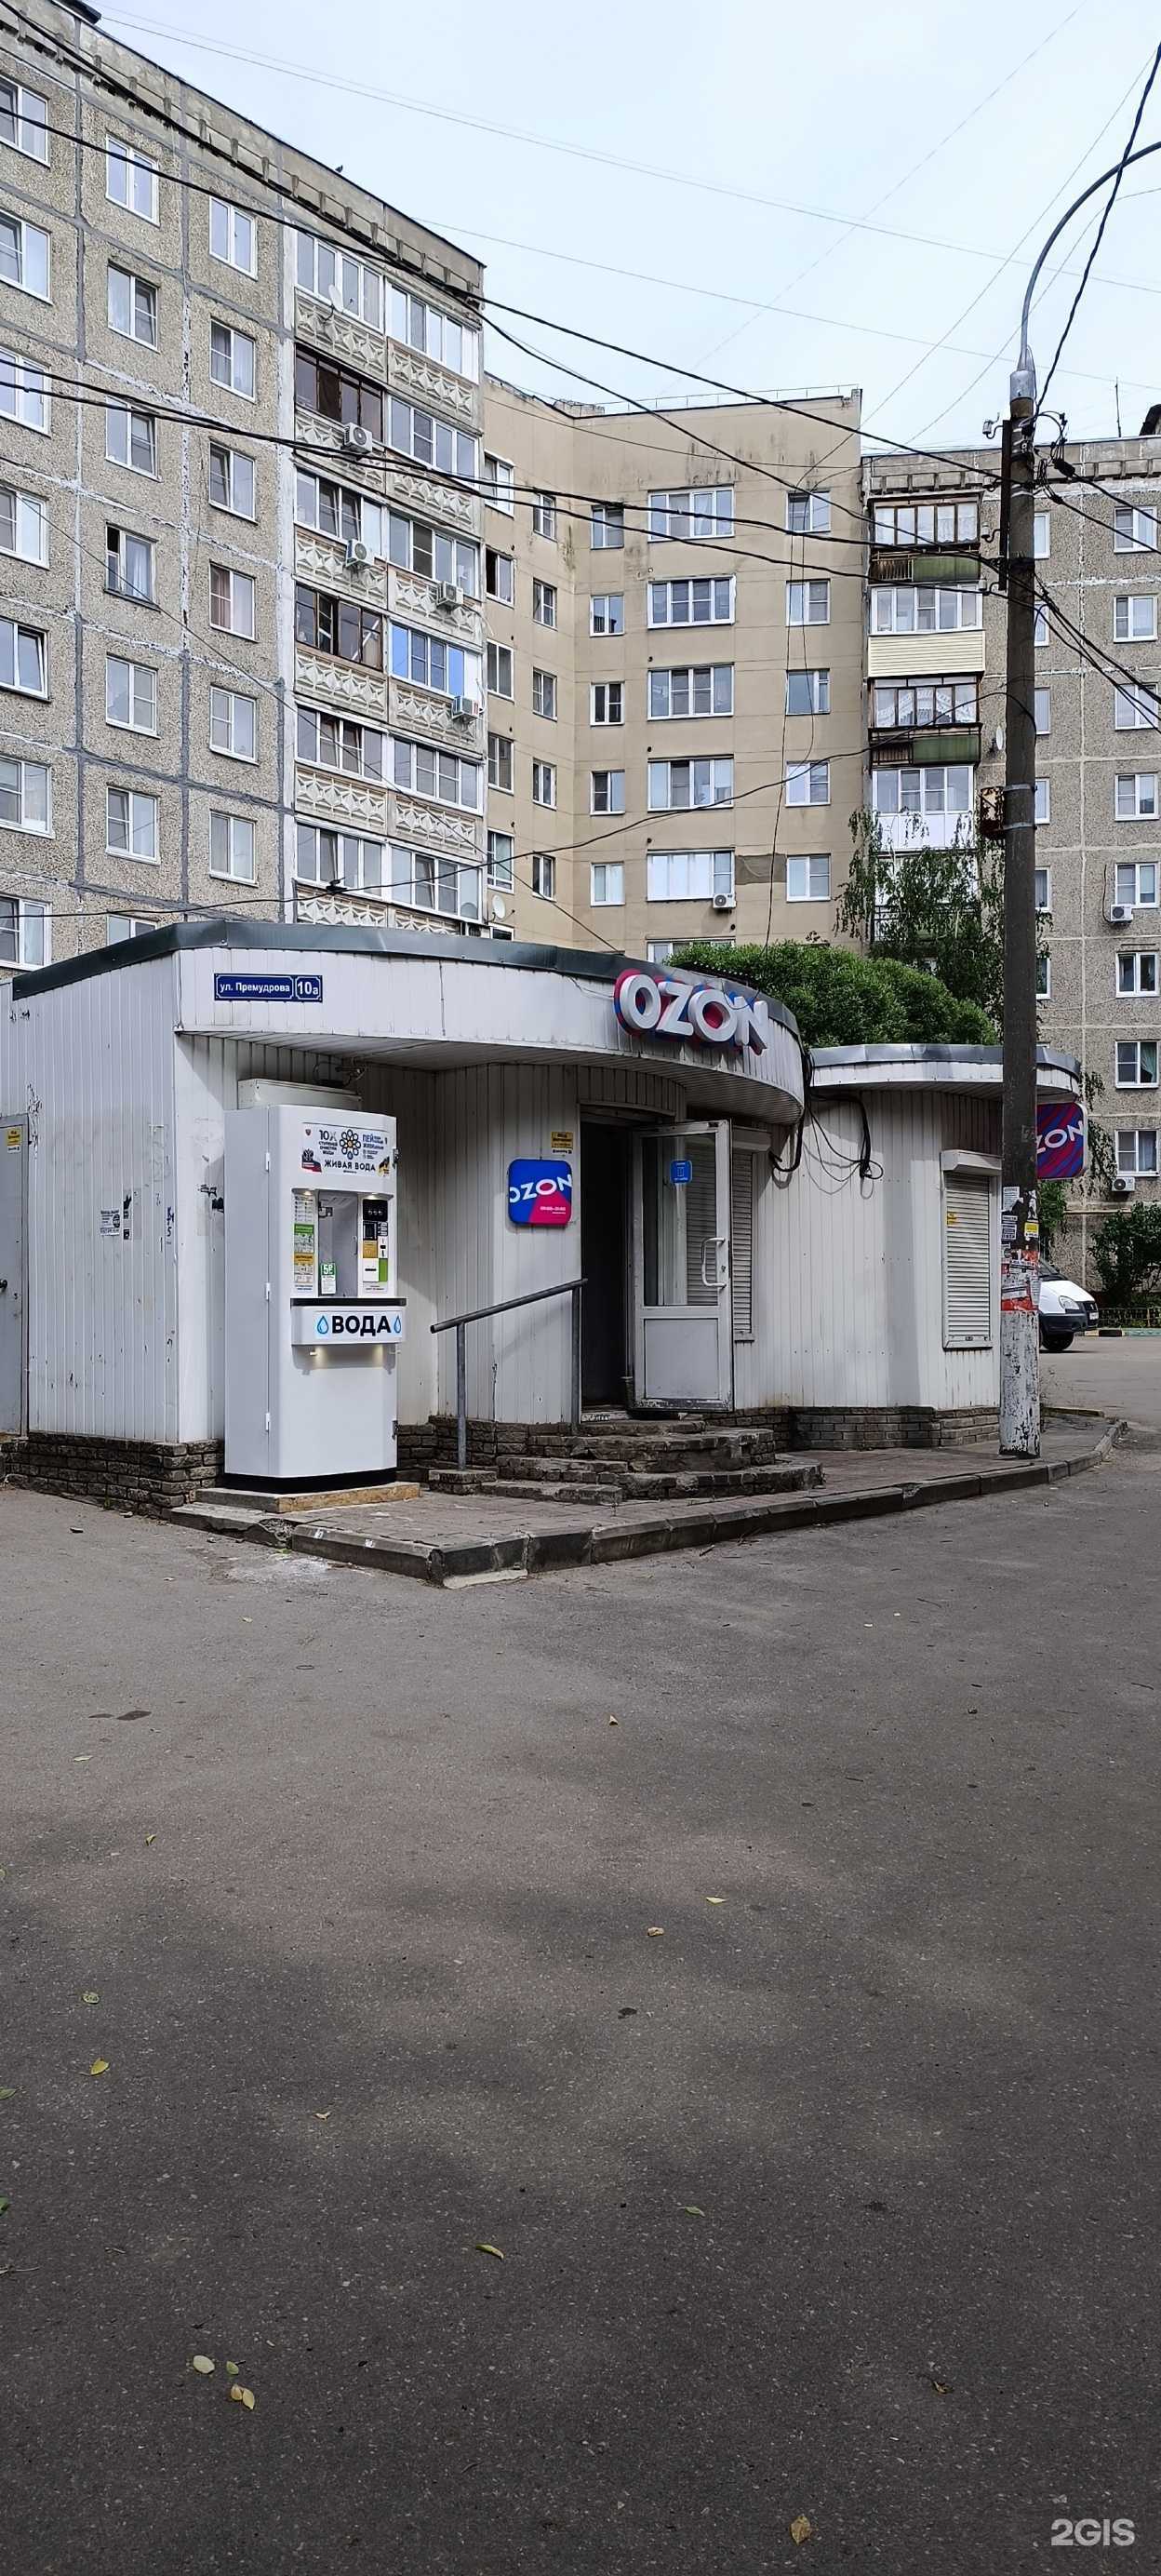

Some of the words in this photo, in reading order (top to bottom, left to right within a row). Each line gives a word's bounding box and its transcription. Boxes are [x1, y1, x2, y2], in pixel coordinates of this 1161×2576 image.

[220, 983, 234, 993] ул.
[235, 983, 290, 993] Премудрова
[619, 973, 769, 1053] OZON
[1036, 1120, 1084, 1154] ZON
[325, 1160, 353, 1169] ЖИВАЯ
[354, 1162, 376, 1172] ВОДА
[331, 1315, 392, 1336] ВОДА
